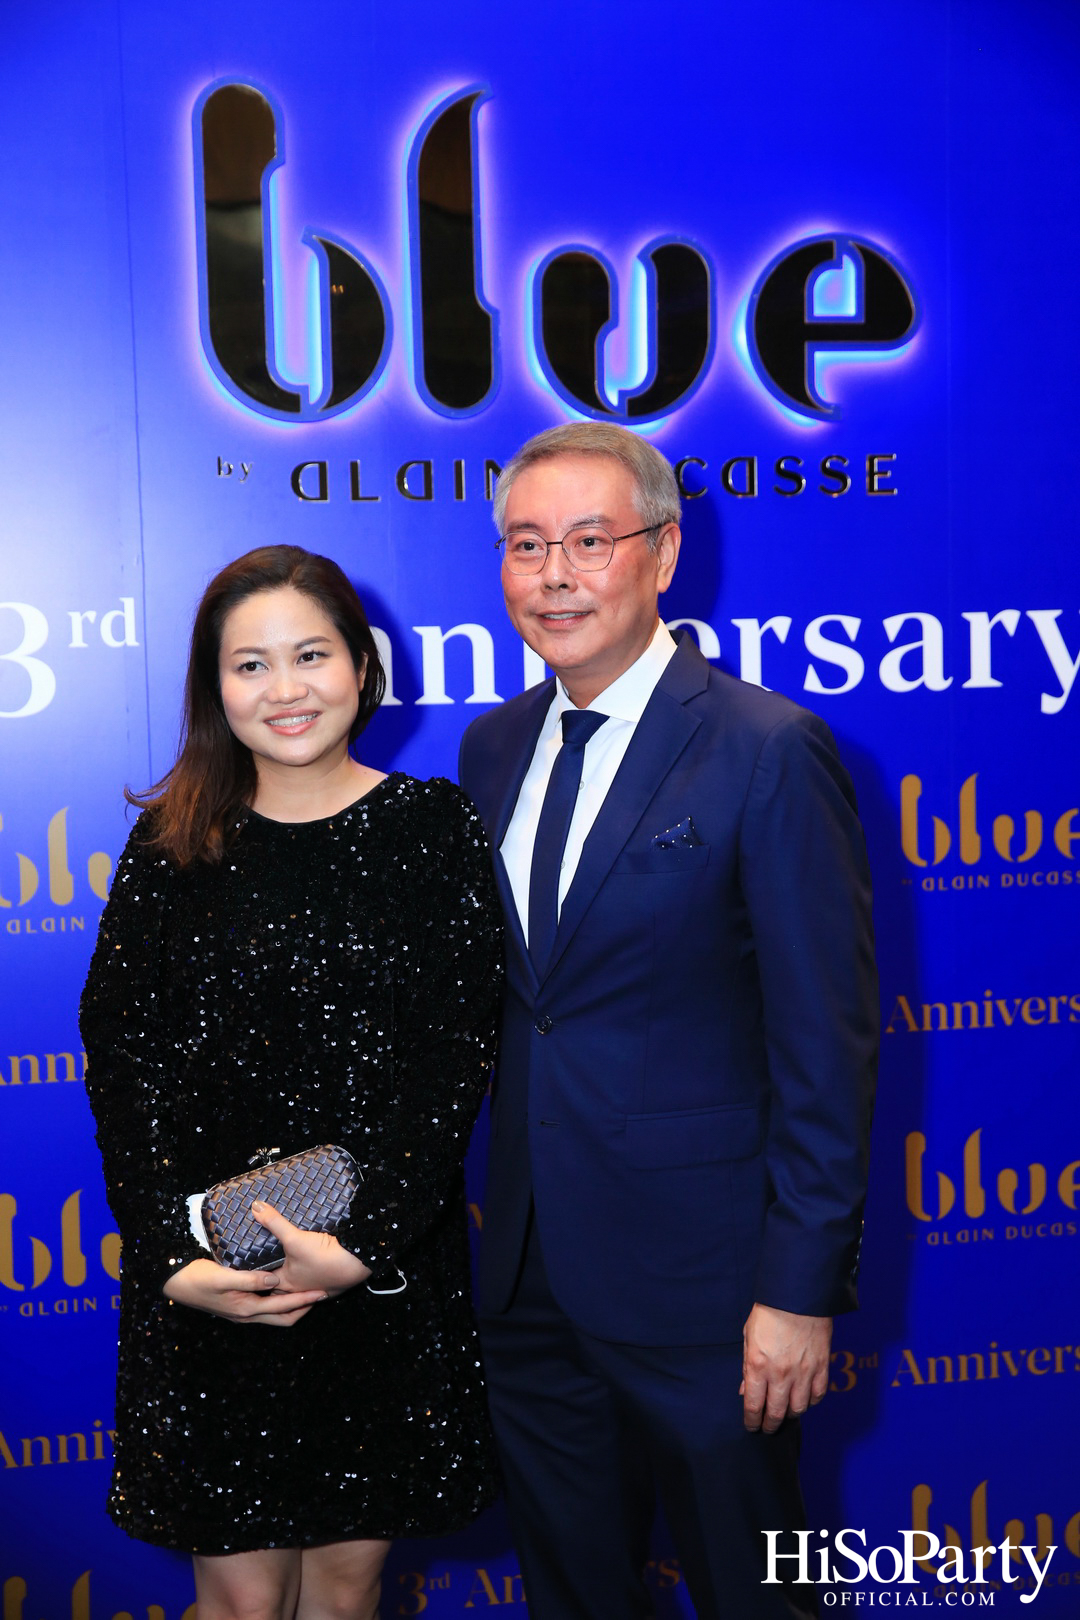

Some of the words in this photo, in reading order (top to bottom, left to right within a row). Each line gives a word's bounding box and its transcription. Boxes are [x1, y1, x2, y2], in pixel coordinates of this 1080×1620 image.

[192, 74, 921, 425] blue
[216, 456, 252, 482] by
[675, 453, 897, 499] CASSE
